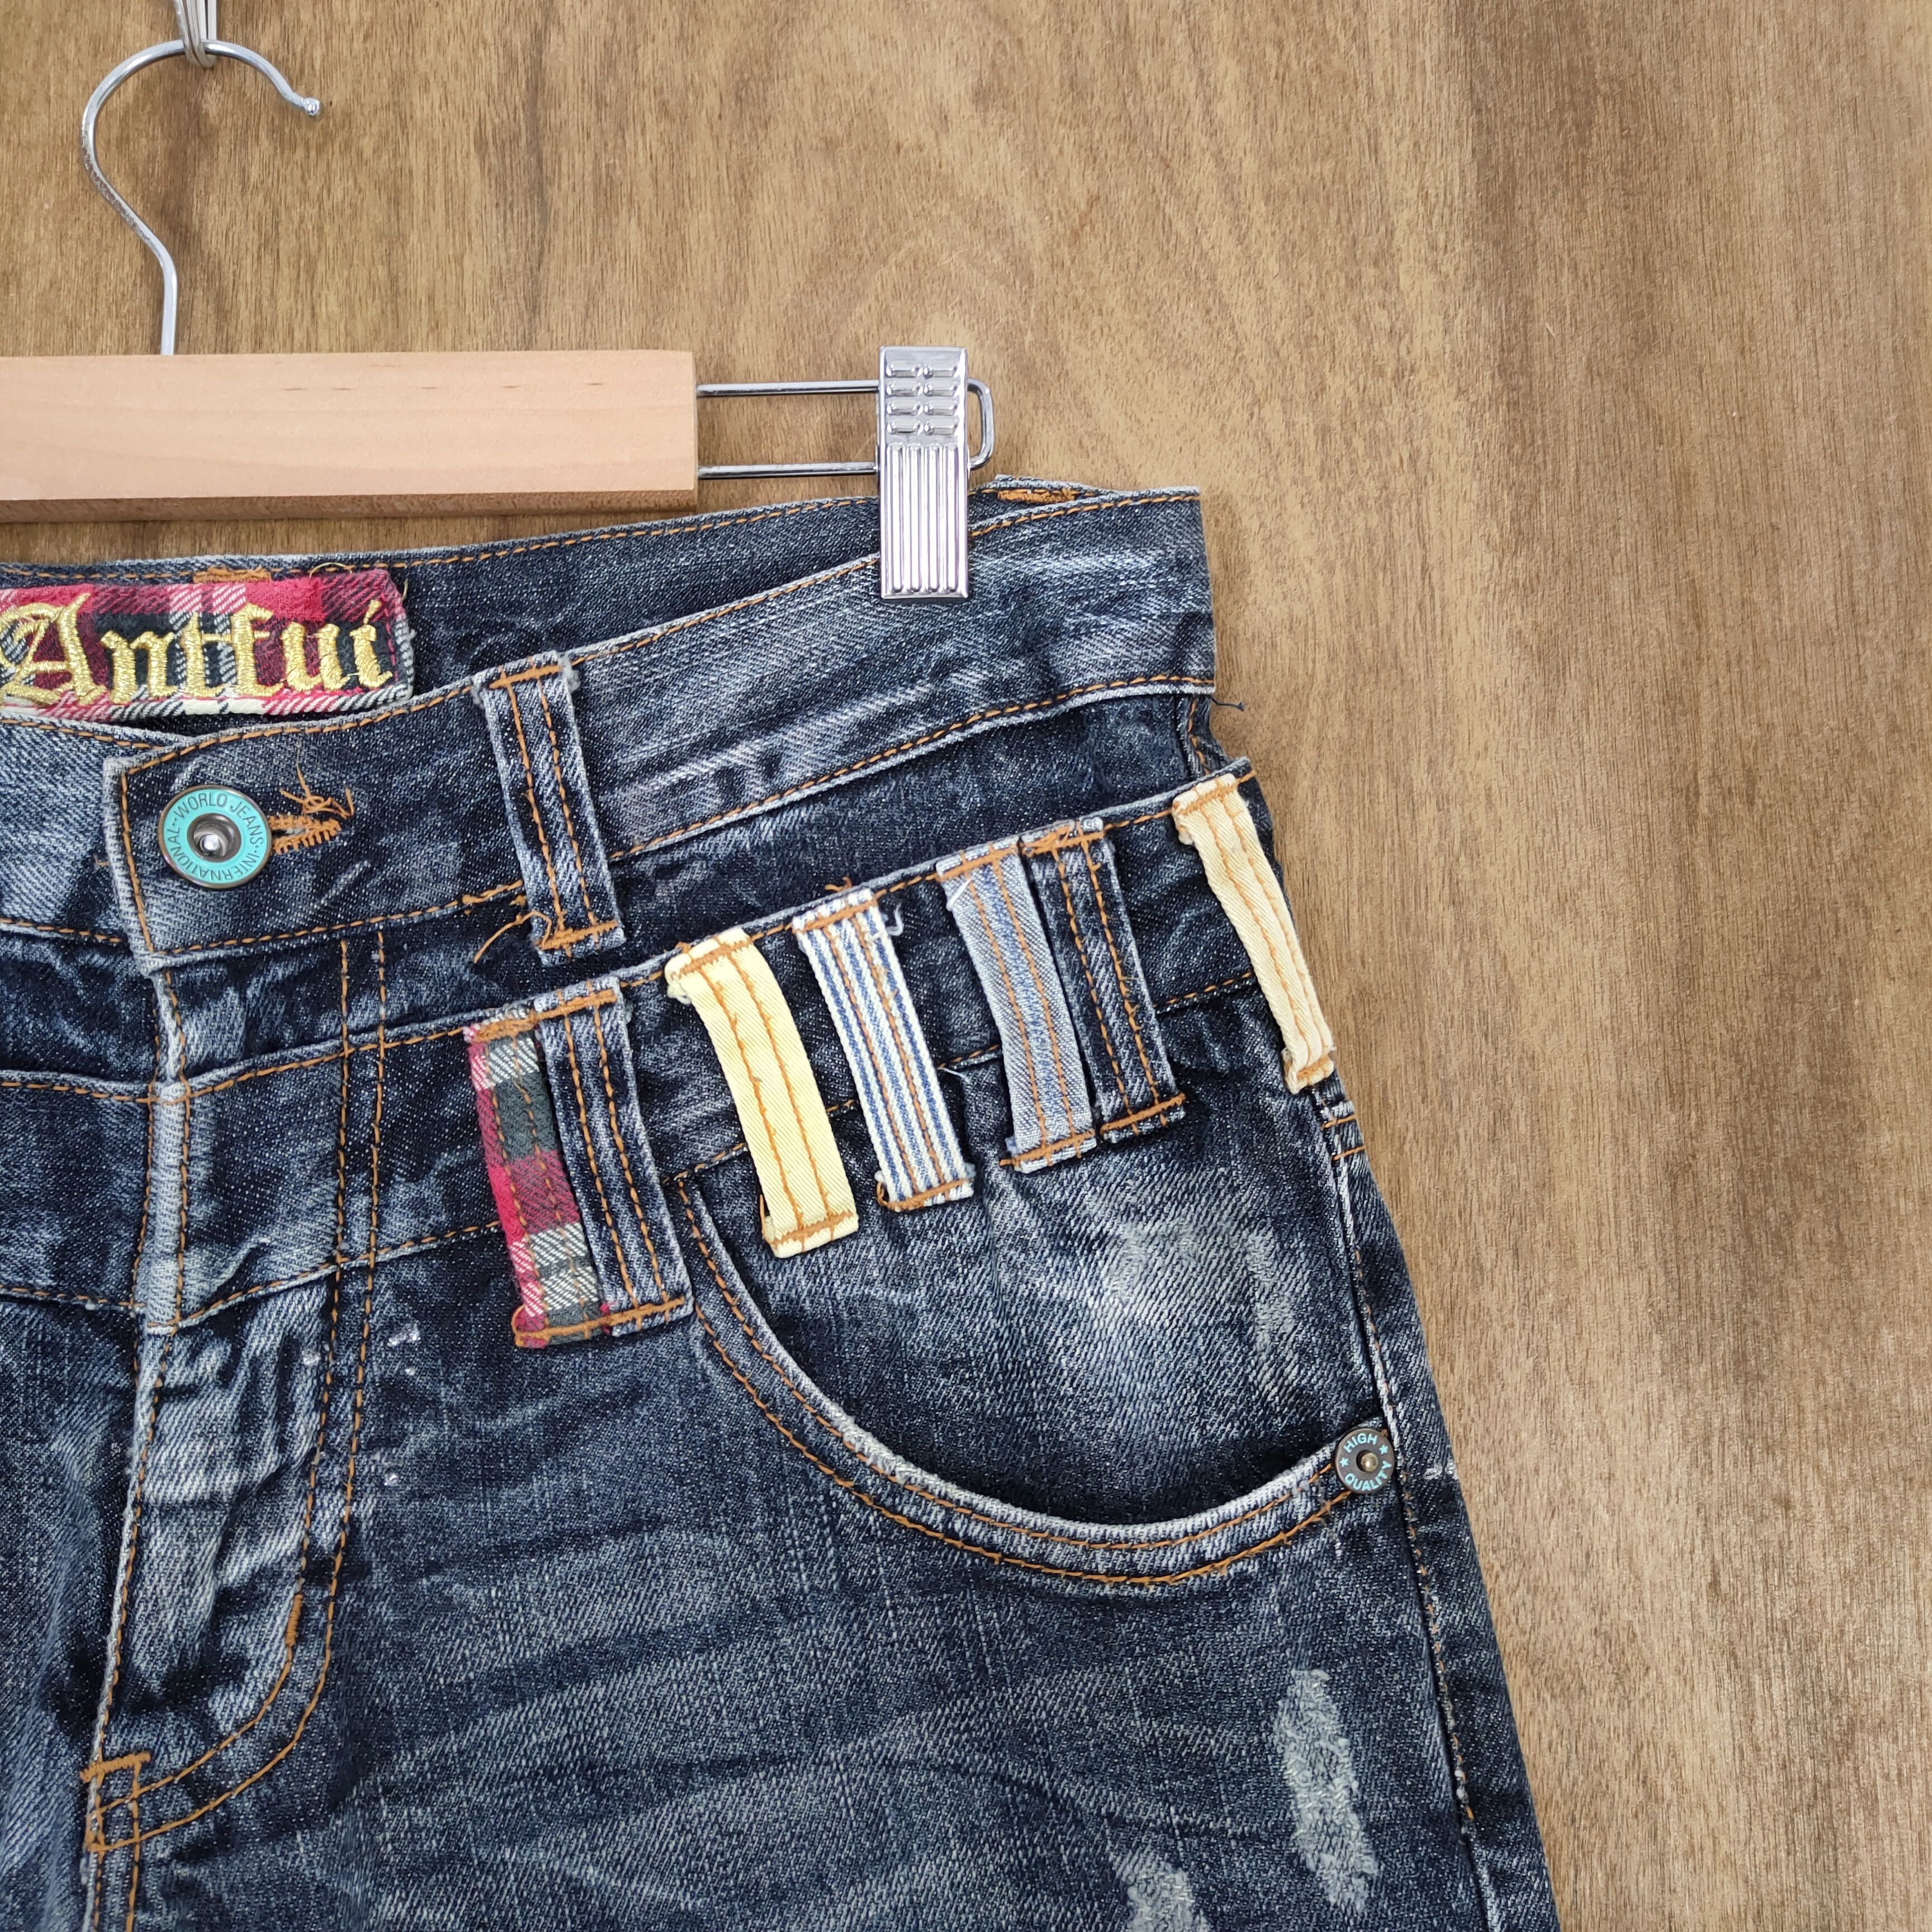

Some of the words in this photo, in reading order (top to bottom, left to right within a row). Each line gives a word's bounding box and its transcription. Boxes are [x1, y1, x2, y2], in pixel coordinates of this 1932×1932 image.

[230, 801, 264, 846] JEANS
[167, 827, 260, 881] INTERNATIONAL
[1343, 1432, 1378, 1453] HIGH
[1344, 1460, 1392, 1491] QUALITY
